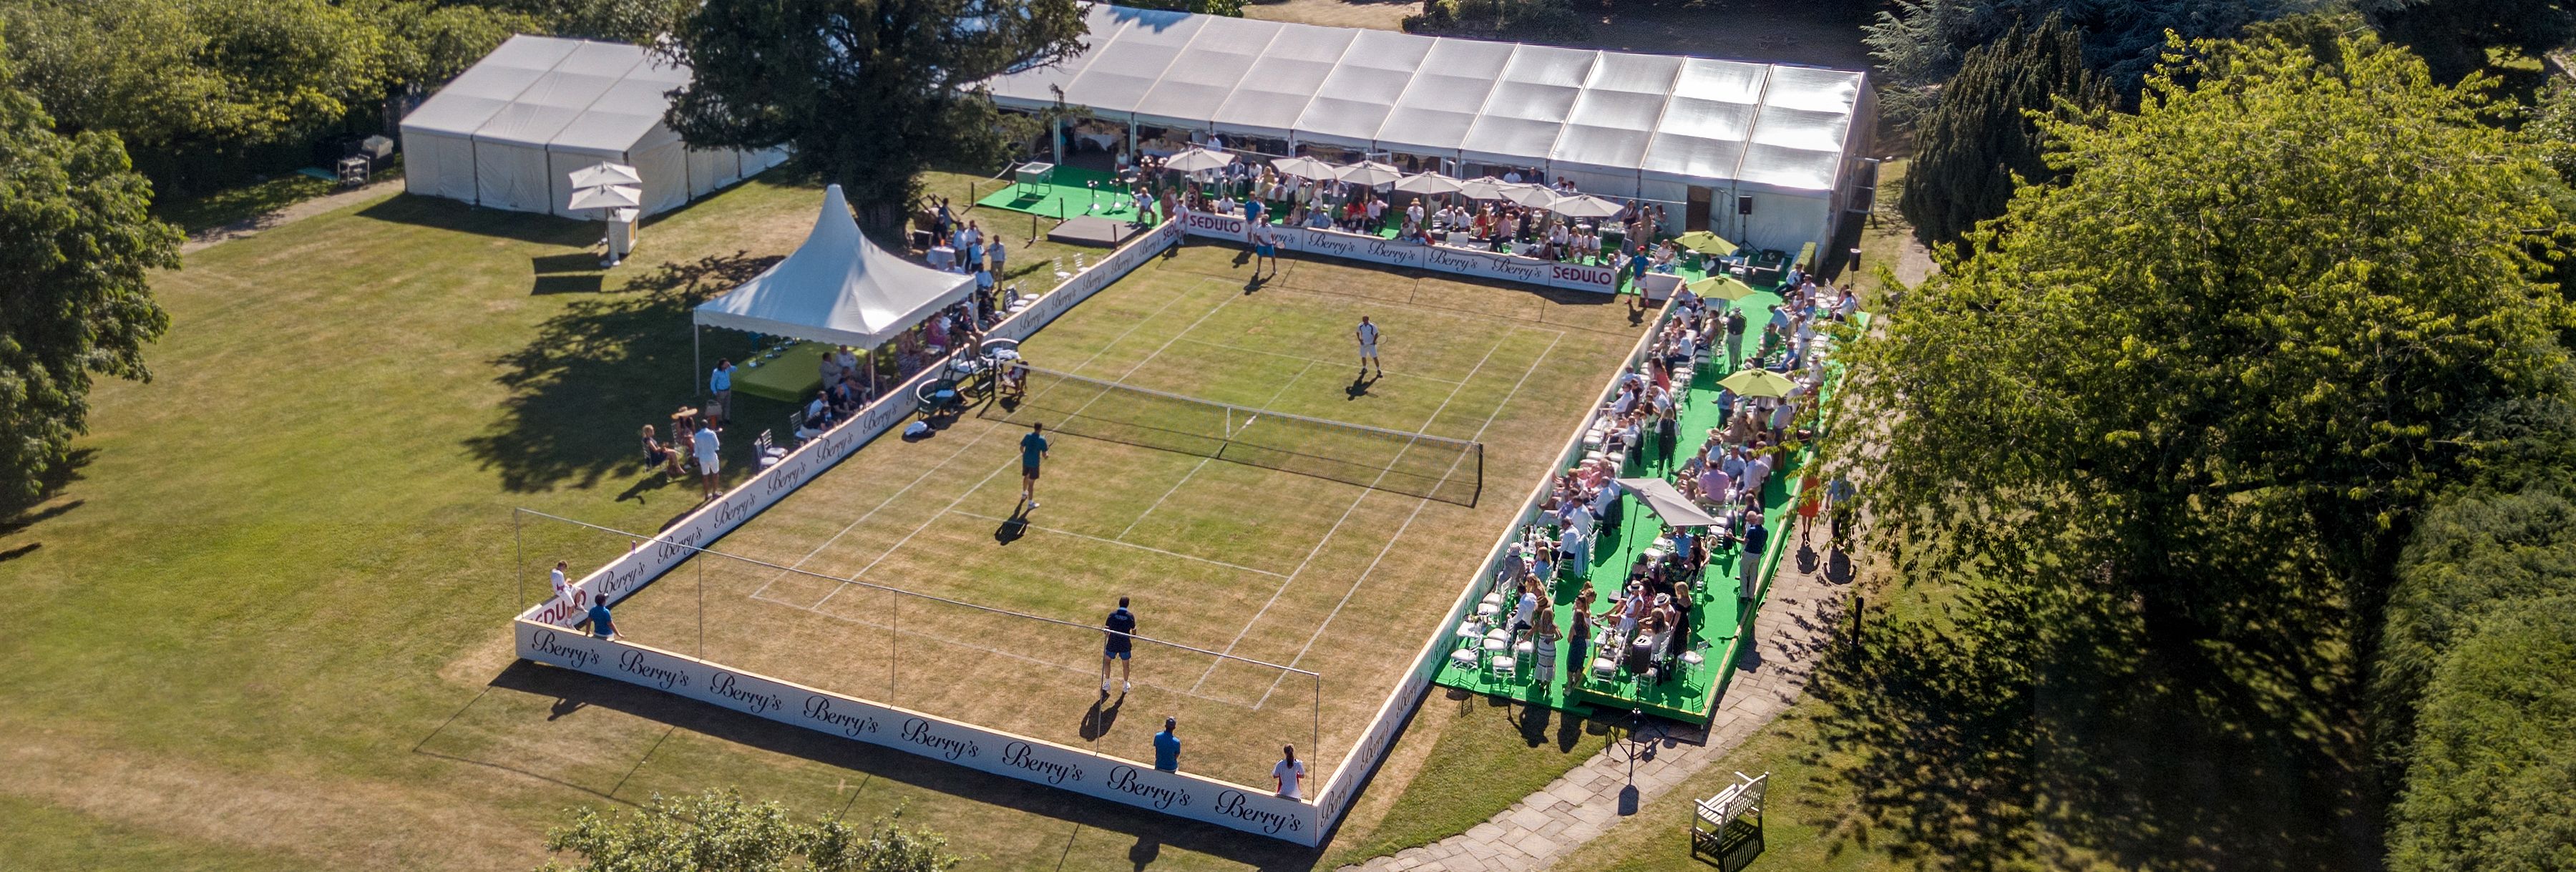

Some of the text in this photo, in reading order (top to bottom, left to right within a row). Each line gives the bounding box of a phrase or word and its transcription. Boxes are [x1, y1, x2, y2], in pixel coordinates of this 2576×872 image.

[1189, 215, 1241, 233] SEDULO
[1308, 232, 1355, 254] Berry's
[1368, 240, 1415, 263] Berry's
[1429, 249, 1478, 272] Berry's
[1492, 256, 1541, 281] Berry's
[1553, 266, 1611, 285] SEDULO
[1019, 308, 1045, 332] Berry's
[1051, 288, 1075, 310] Berry's
[599, 562, 645, 595] Berry's
[658, 526, 703, 564] Berry's
[714, 494, 755, 528] Berry's
[767, 462, 806, 495] Berry's
[816, 432, 853, 464] Berry's
[863, 403, 897, 434] Berry's
[532, 629, 1303, 834] Berry's Berry's Berry's Berry's Berry's Berry's Berry's Berry's
[1321, 773, 1352, 827] Berry's
